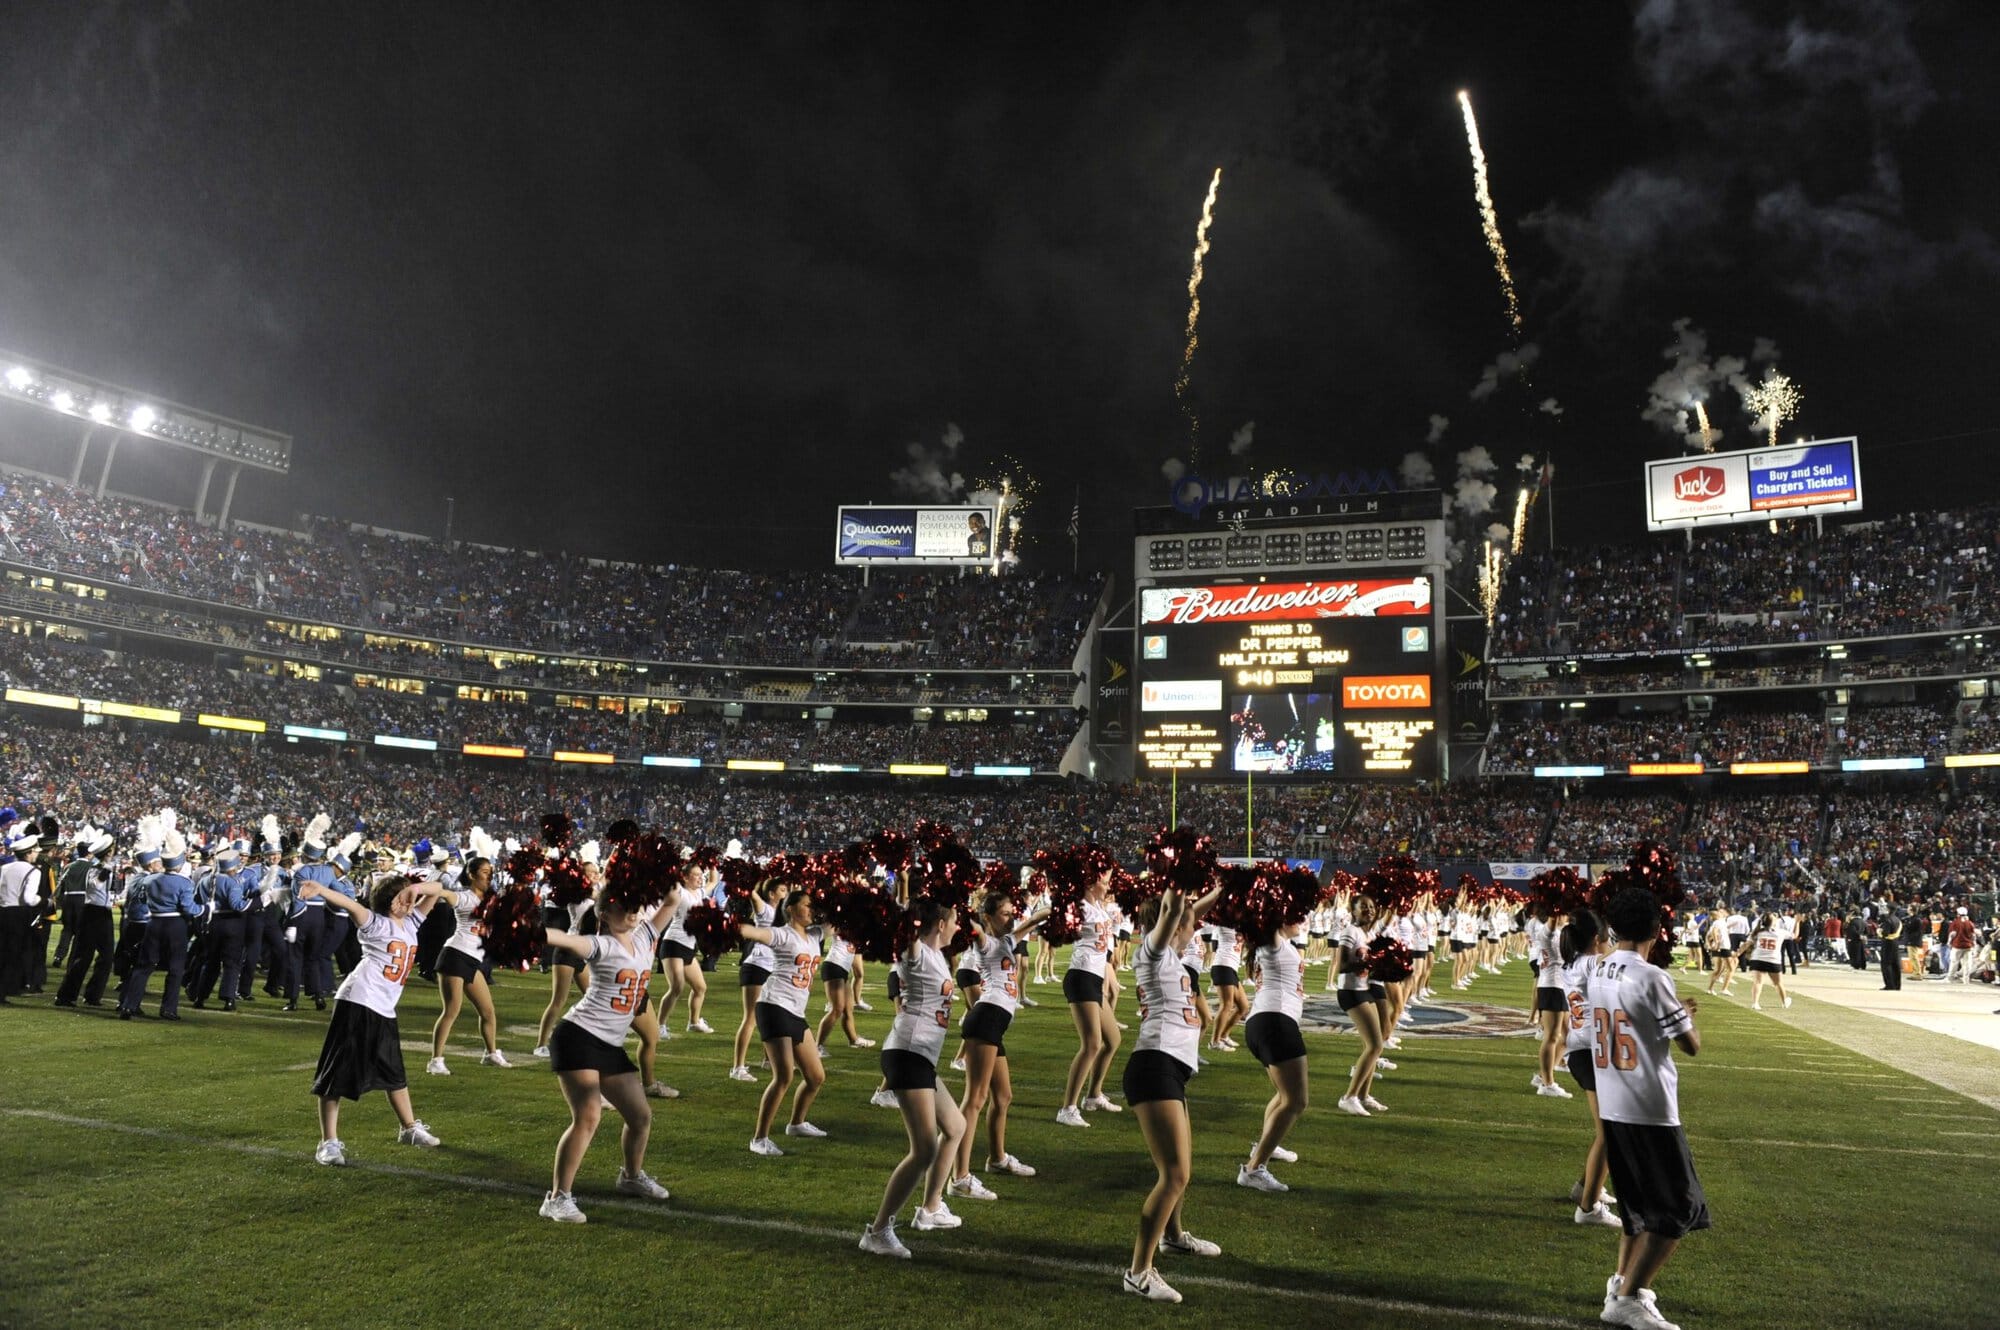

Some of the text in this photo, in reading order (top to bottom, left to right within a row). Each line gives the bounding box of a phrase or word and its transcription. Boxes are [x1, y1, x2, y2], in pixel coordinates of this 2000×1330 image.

[1769, 464, 1832, 482] Buy and Sell
[1676, 470, 1724, 499] Jack
[1756, 475, 1848, 494] Chargers Tickets!
[1217, 502, 1377, 520] STADIUM
[844, 523, 912, 538] QUALCOMM
[919, 522, 967, 530] POMERADO
[1171, 583, 1359, 624] Budweiser
[1250, 624, 1312, 636] THANKS TO
[1240, 637, 1322, 650] DR PEPPER
[1219, 650, 1349, 666] HALFTIME SHOW
[1100, 685, 1129, 698] Sprint
[1347, 684, 1427, 701] TOYOTA
[1450, 679, 1484, 693] Sprint
[1759, 938, 1777, 950] 36
[1594, 1007, 1639, 1072] 36
